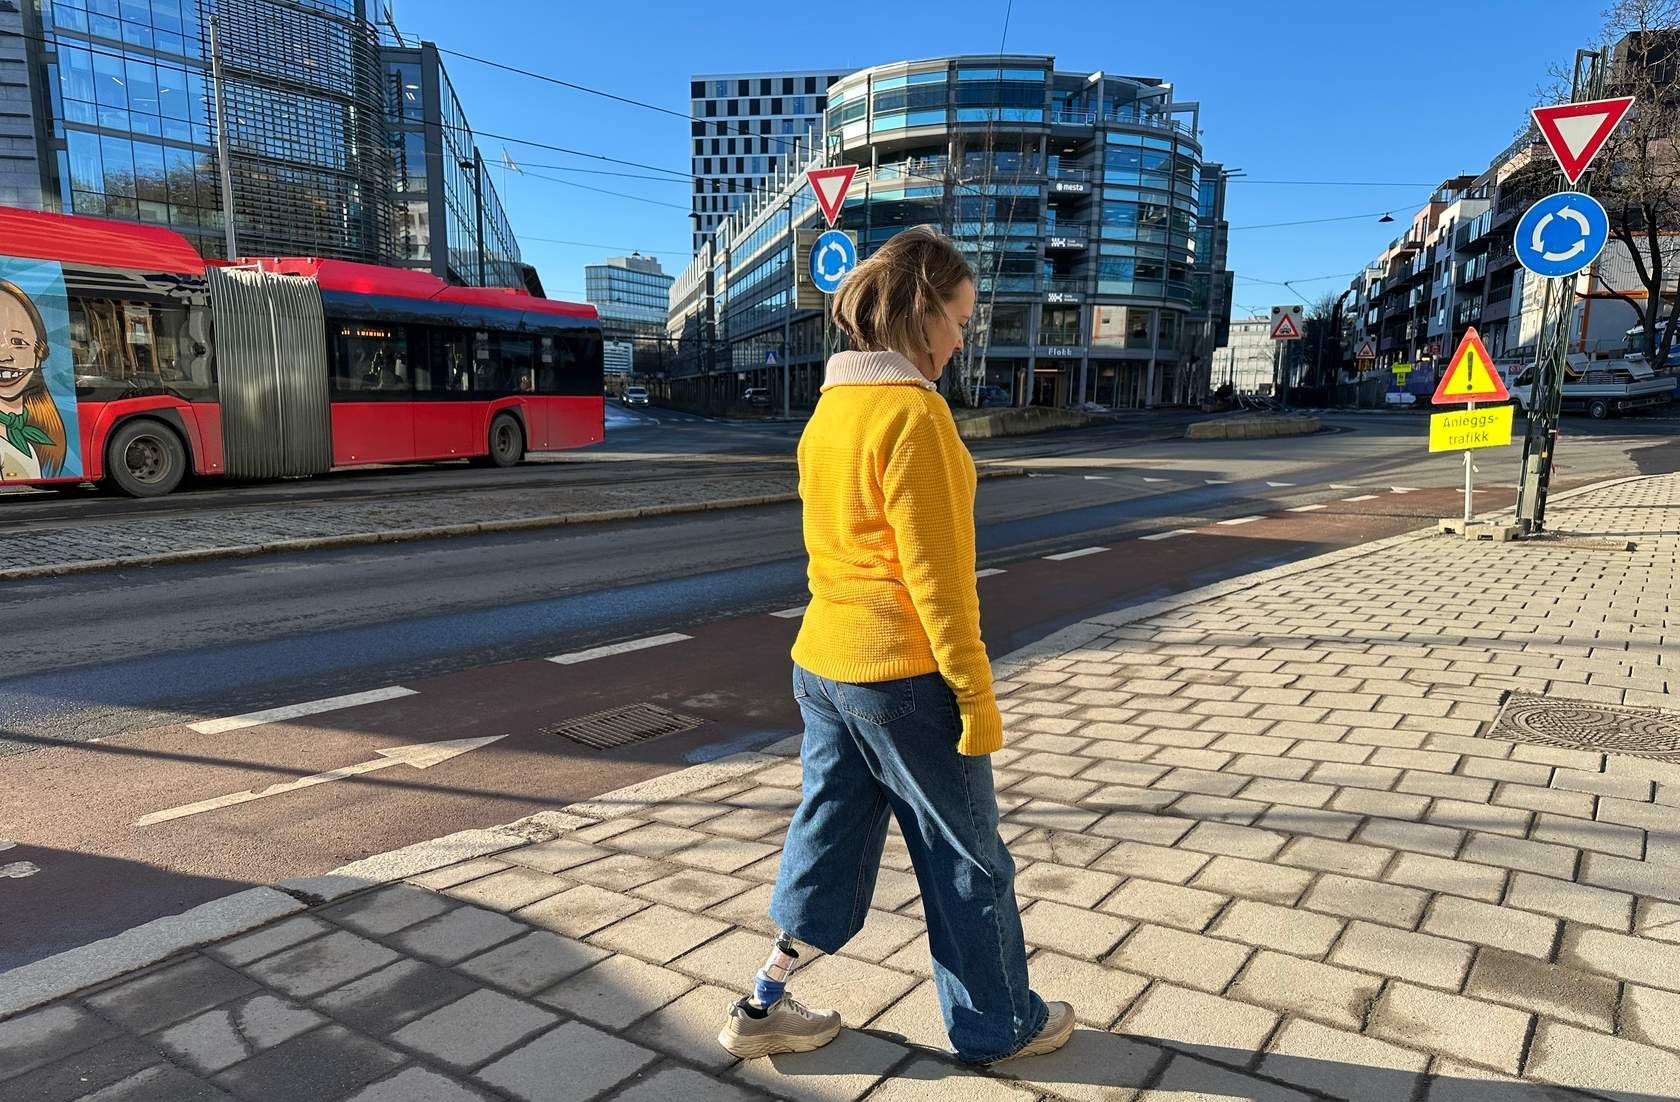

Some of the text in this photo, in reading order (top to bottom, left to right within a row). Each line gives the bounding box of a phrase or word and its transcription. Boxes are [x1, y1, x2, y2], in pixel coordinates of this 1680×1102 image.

[1063, 183, 1084, 192] mesta
[1443, 415, 1499, 429] Anleggs-
[1449, 431, 1489, 446] trafikk
